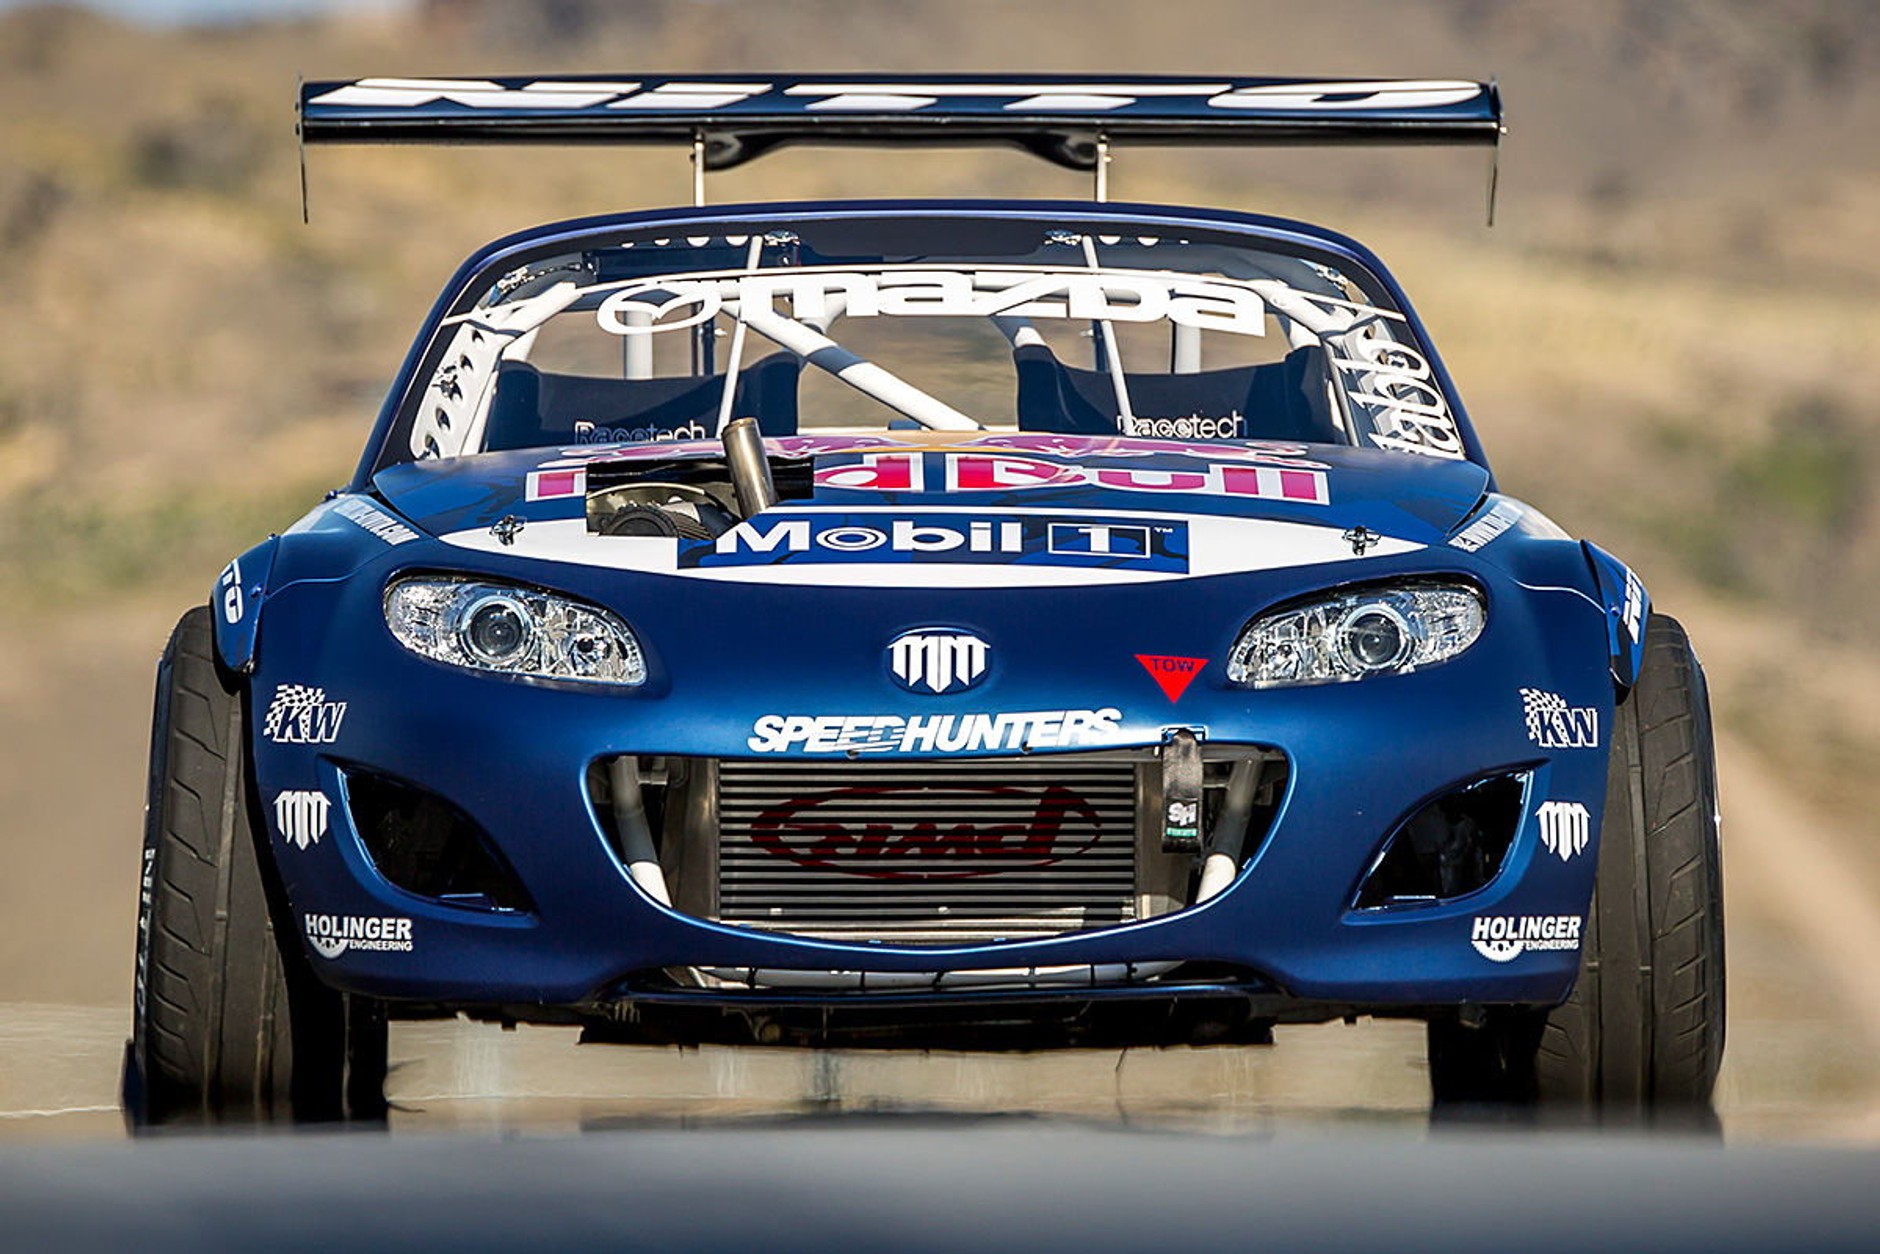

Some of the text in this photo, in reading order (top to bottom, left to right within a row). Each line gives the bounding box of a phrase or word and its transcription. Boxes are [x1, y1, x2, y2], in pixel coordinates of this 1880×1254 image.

[308, 77, 1482, 109] NITTO
[740, 273, 1266, 337] mazda
[943, 452, 1330, 506] Bull
[716, 520, 1023, 554] Mobil
[1078, 525, 1110, 553] 1
[1150, 657, 1196, 674] TOW
[272, 701, 347, 743] KW
[747, 707, 1123, 753] SPEEDHUNTERS
[1537, 707, 1599, 748] KW
[304, 913, 414, 941] HOLINGER
[1471, 915, 1582, 940] HOLINGER
[349, 938, 414, 952] ENGINEERING
[1524, 939, 1580, 951] ENGINEERING
